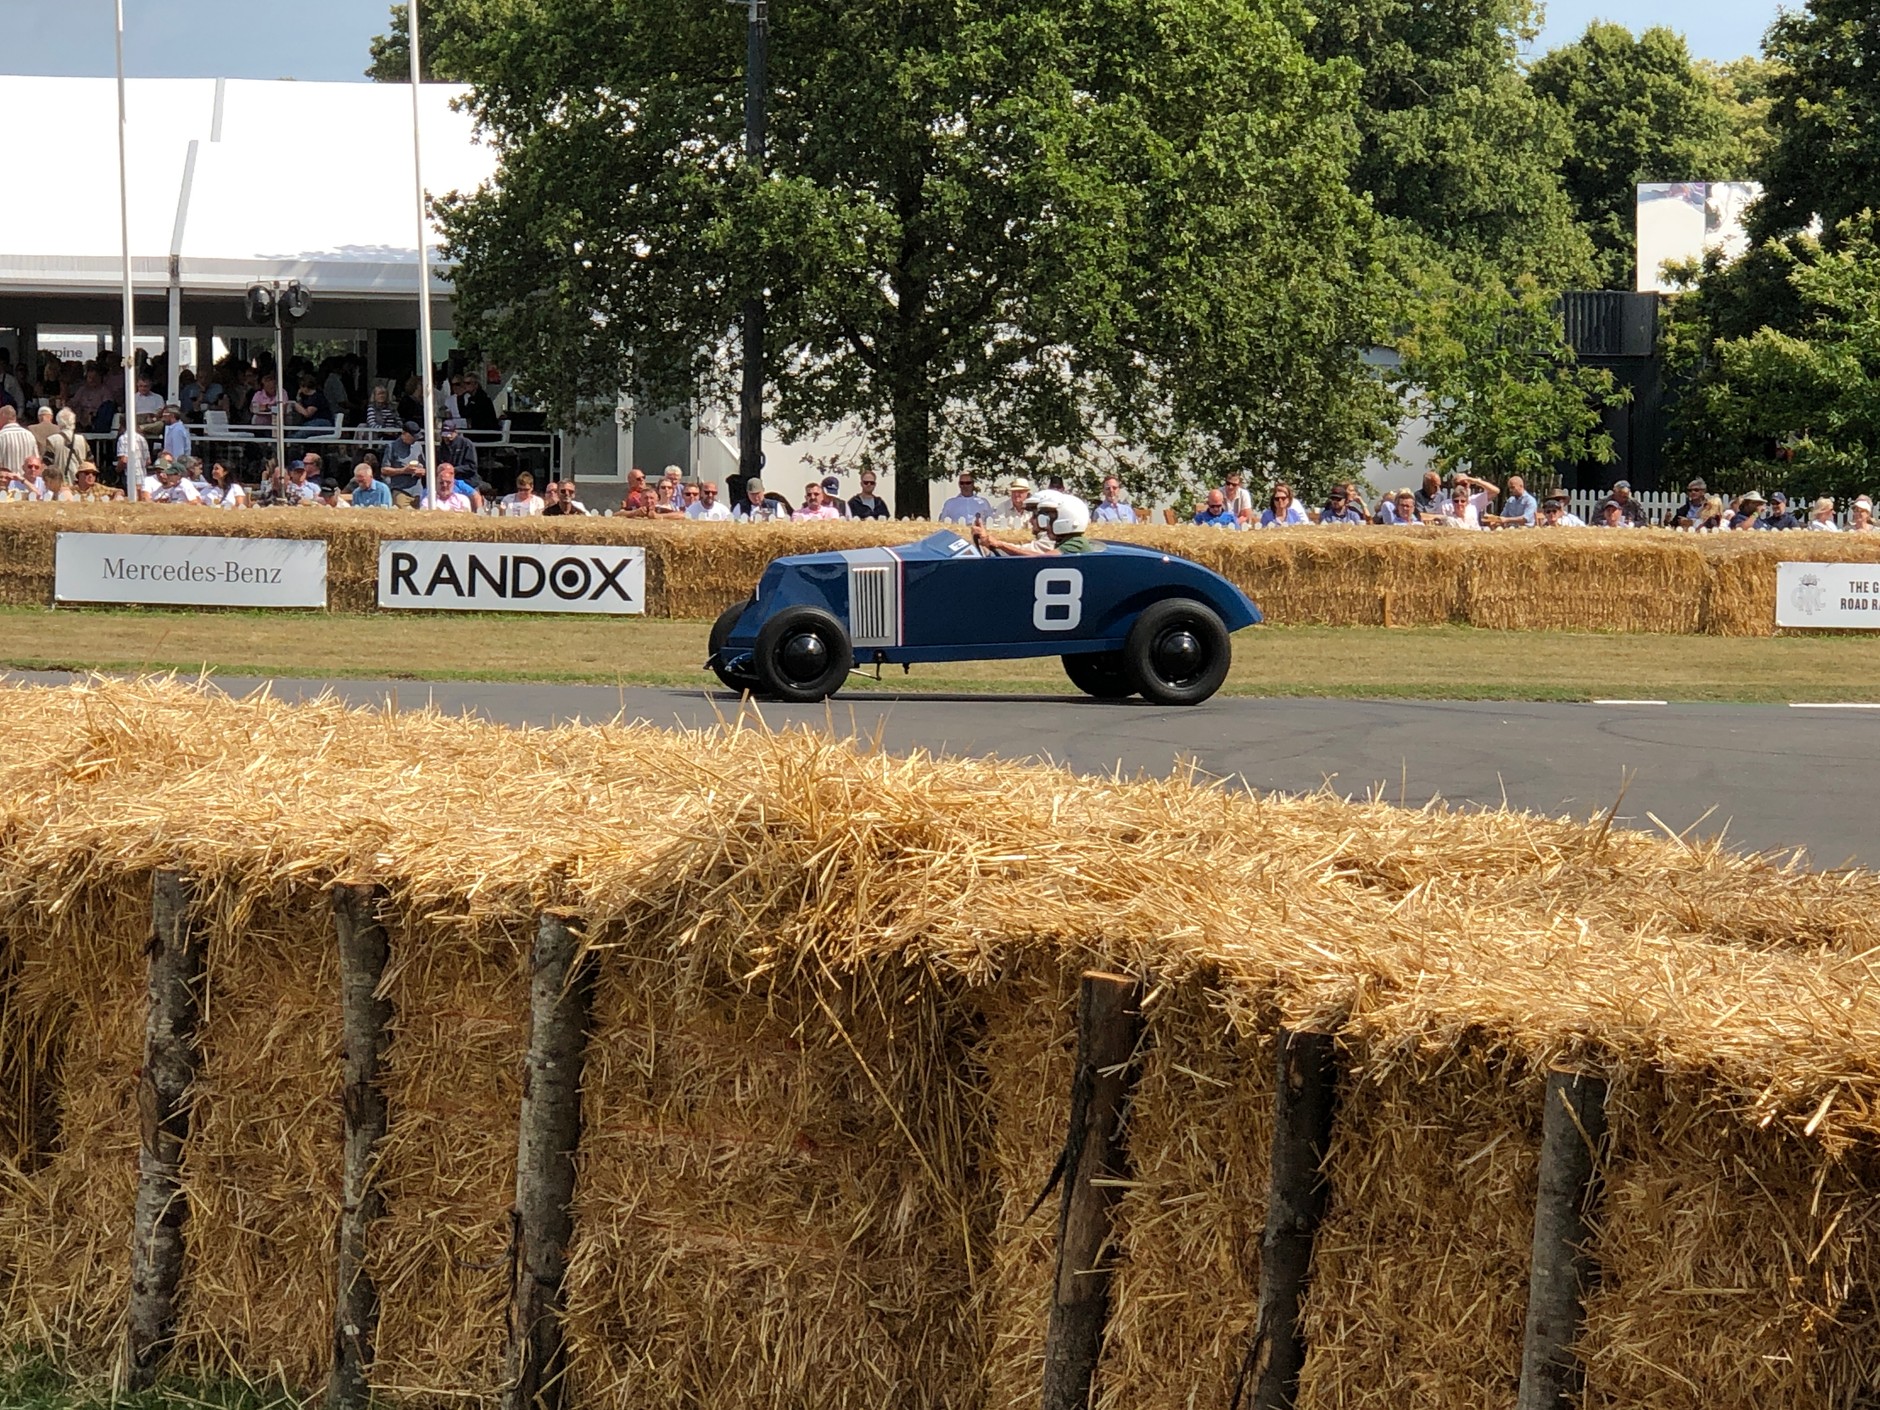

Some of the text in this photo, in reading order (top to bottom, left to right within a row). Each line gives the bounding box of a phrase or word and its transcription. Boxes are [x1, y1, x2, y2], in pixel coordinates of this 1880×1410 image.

[102, 558, 282, 584] Mercedes-Benz
[390, 552, 633, 601] RANDOX
[1033, 568, 1083, 630] 8
[1849, 581, 1869, 593] THE
[1840, 598, 1880, 610] ROAD R
